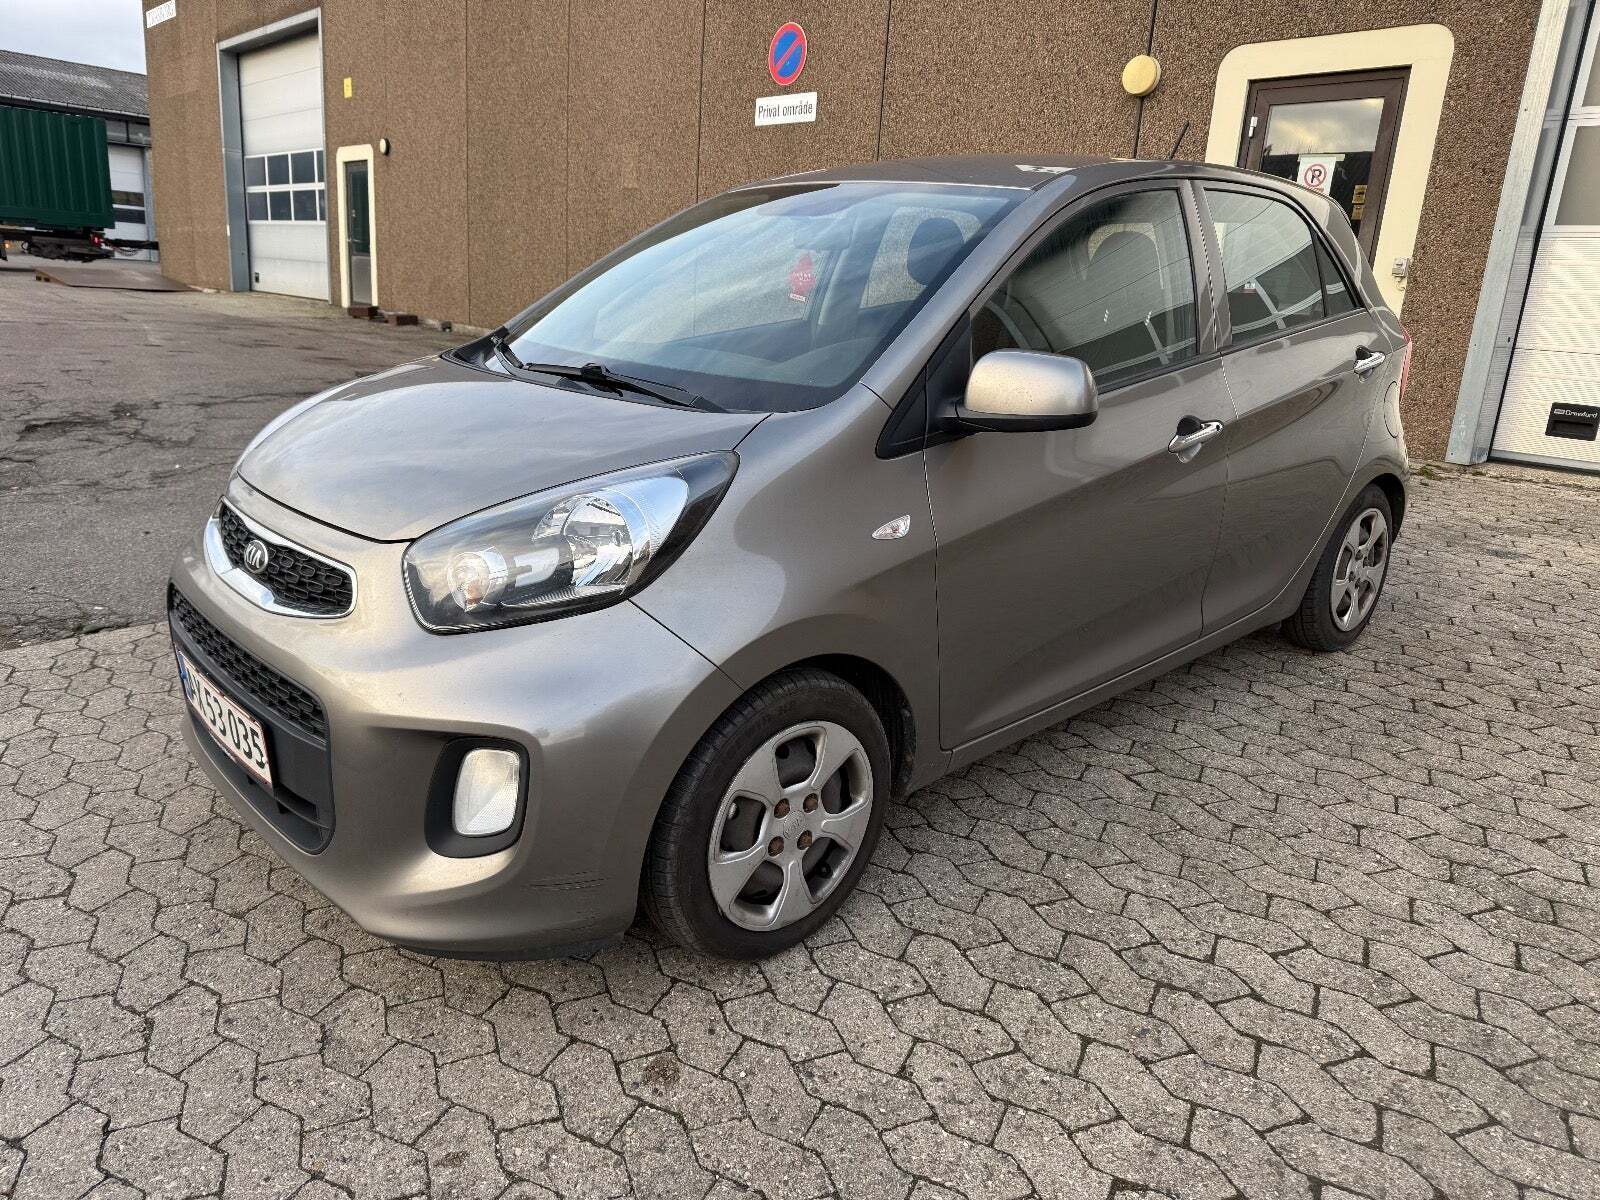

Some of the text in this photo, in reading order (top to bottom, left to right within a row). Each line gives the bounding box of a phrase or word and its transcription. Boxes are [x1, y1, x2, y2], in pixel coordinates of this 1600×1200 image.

[758, 100, 813, 118] Privat område
[204, 687, 226, 737] 53
[227, 708, 265, 769] 035
